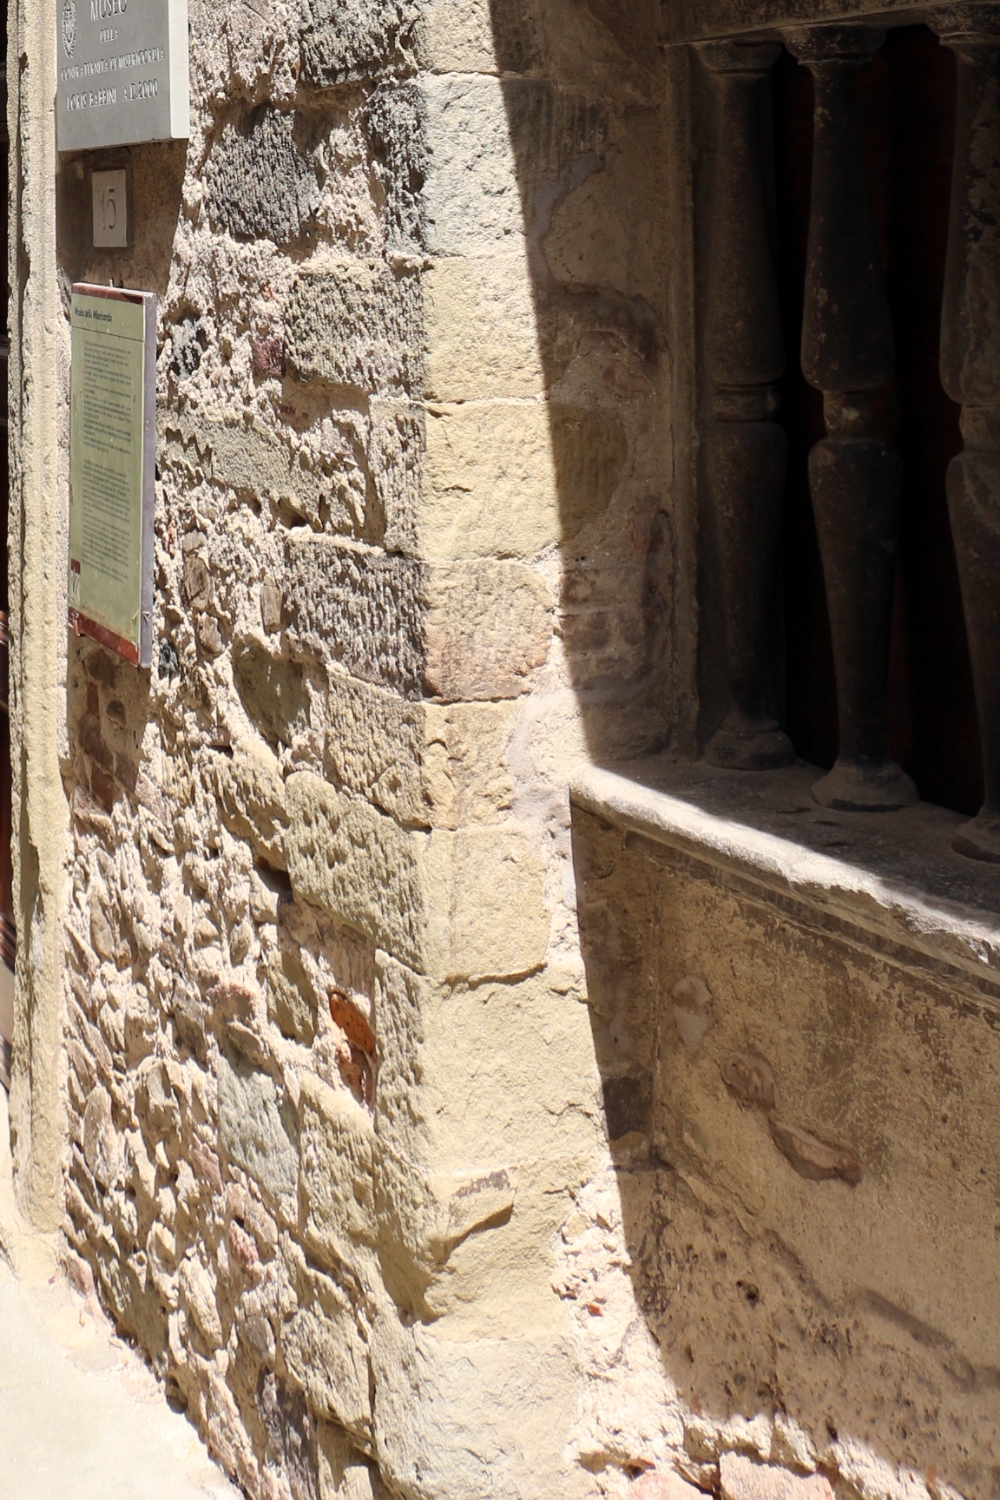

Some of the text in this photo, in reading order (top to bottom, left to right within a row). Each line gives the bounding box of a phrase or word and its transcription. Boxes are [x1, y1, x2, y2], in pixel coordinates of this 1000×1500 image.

[99, 27, 118, 43] DELLA
[110, 57, 117, 71] DI
[119, 46, 165, 69] MISERICORDIA
[67, 92, 87, 111] LORIS
[100, 188, 117, 230] 15
